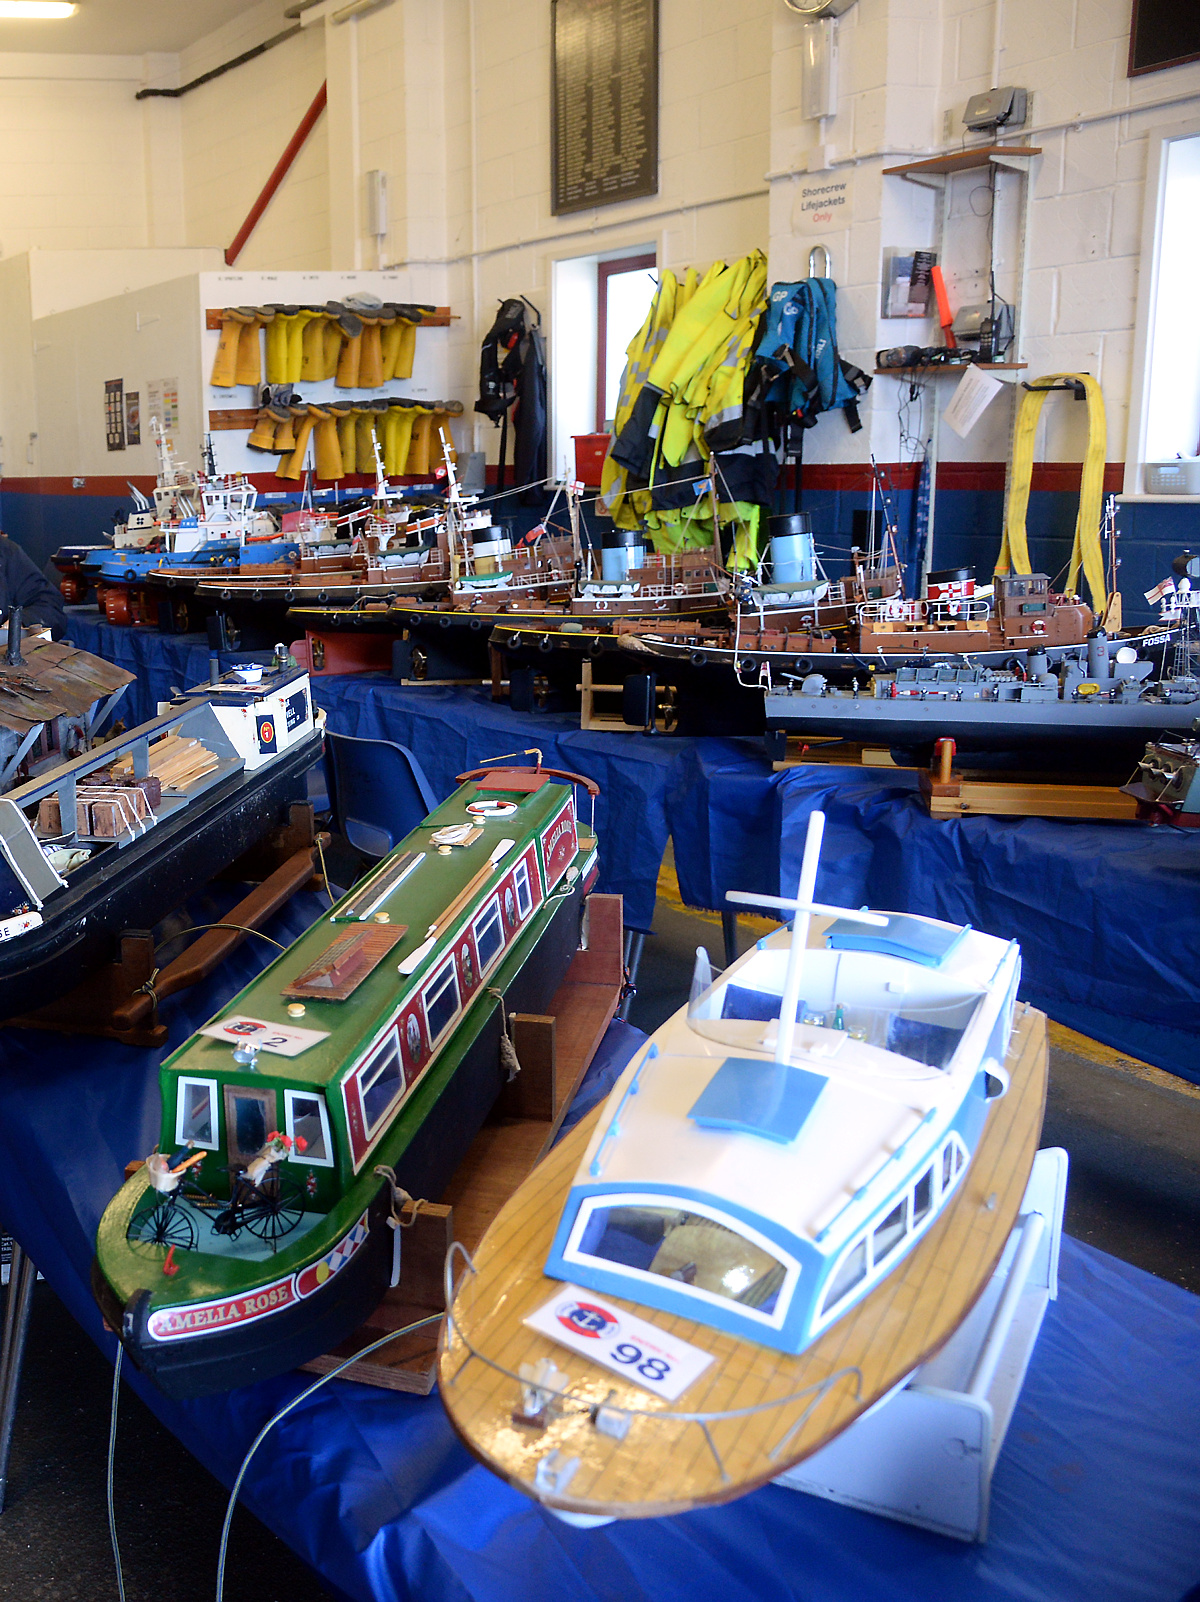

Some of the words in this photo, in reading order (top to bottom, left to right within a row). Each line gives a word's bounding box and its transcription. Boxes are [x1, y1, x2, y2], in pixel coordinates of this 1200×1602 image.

[802, 183, 847, 198] Shorecrew
[801, 196, 845, 211] Lifejackets
[812, 212, 833, 223] Only
[1142, 633, 1171, 648] FOSSA
[1096, 646, 1105, 657] 3
[262, 1036, 288, 1048] 2
[157, 1304, 242, 1333] AMELIA
[242, 1285, 289, 1315] ROSE
[610, 1343, 671, 1382] 98
